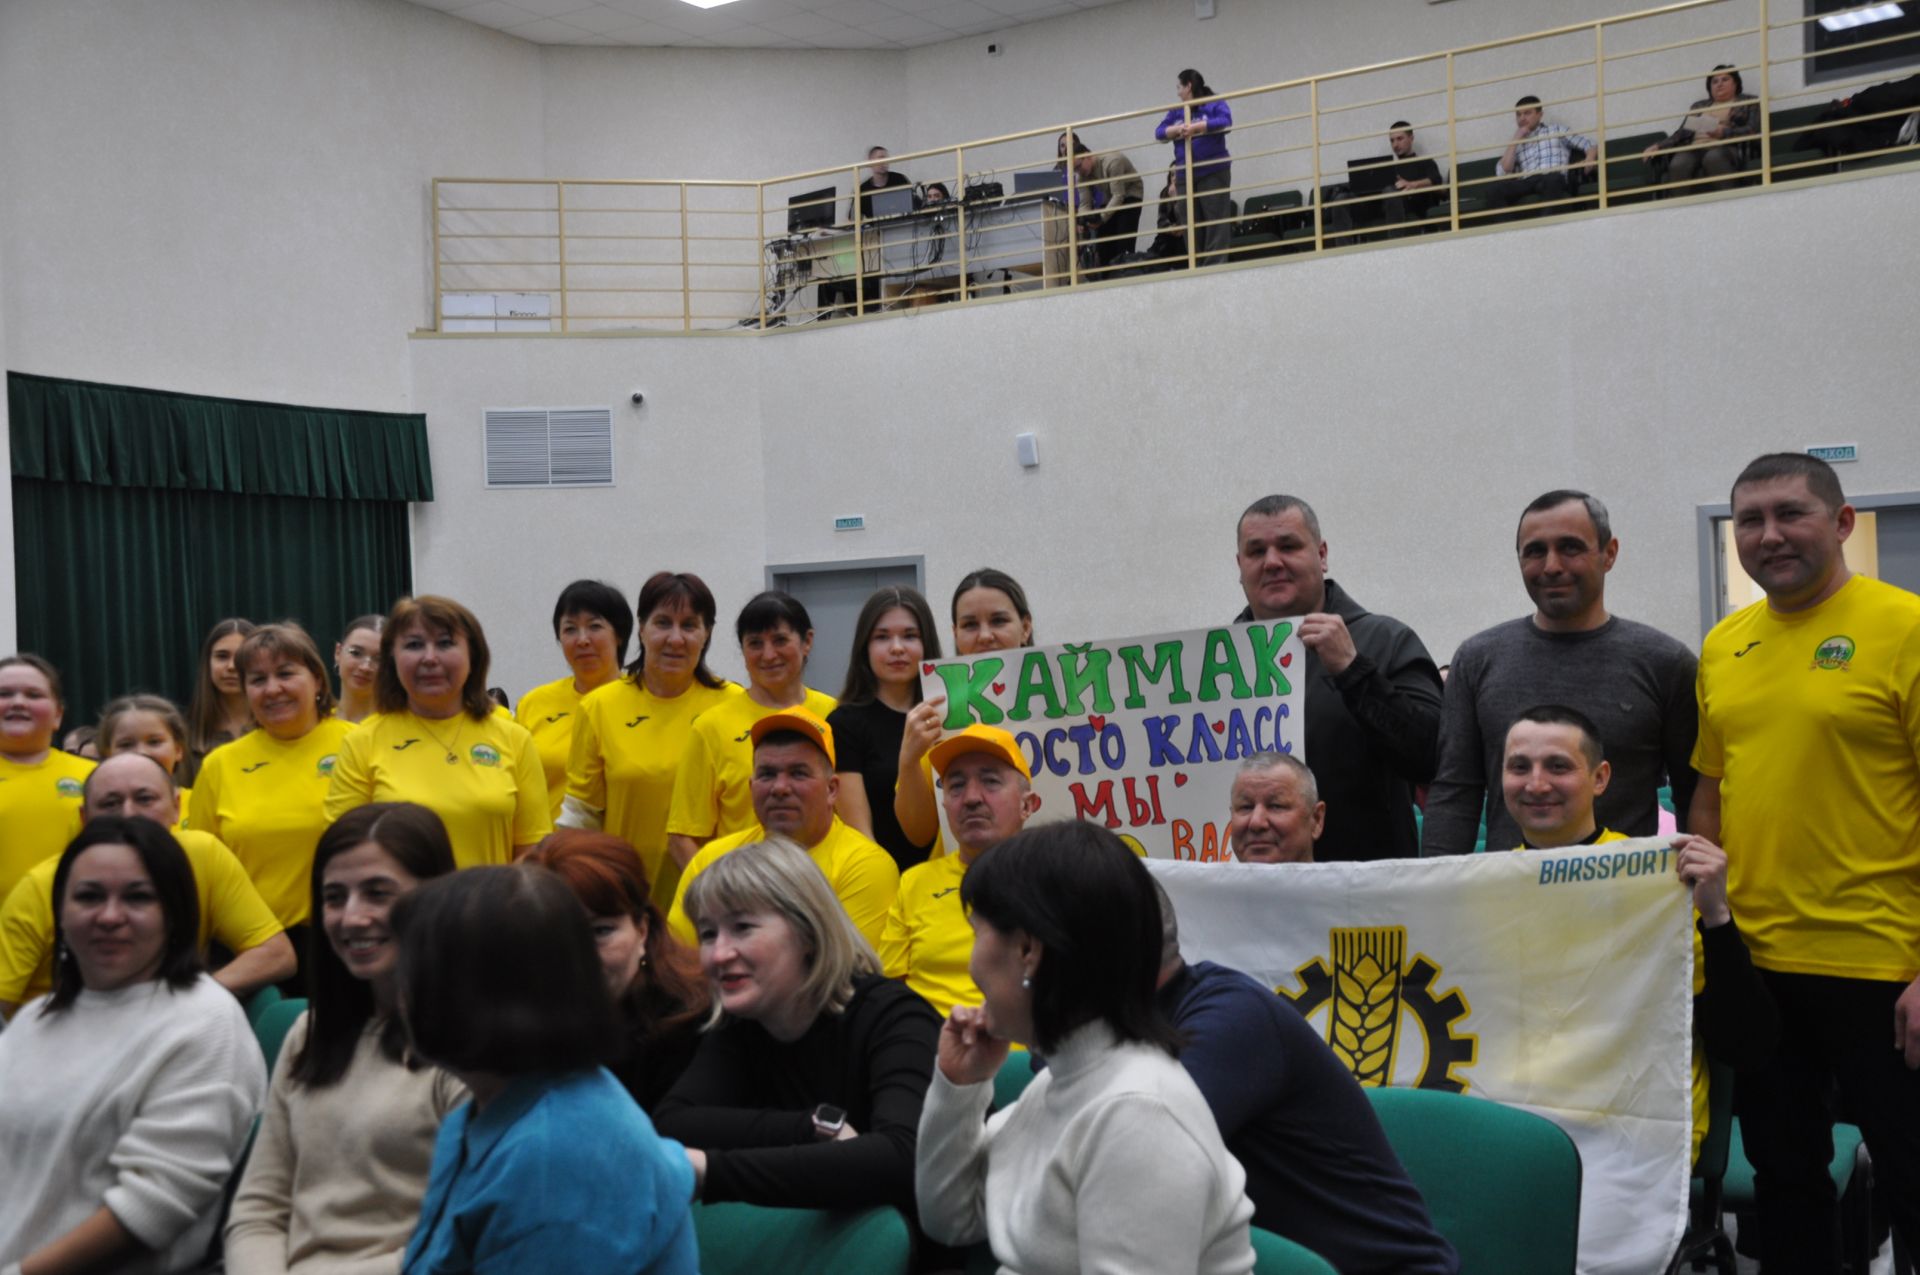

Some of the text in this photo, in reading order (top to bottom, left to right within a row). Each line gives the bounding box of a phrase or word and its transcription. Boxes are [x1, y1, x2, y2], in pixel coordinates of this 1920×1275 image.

[935, 622, 1293, 730] КАЙМАК
[1015, 703, 1292, 778] ОСТО КЛАСС
[1068, 774, 1167, 829] МЫ
[1539, 847, 1671, 885] BARSSPORT
